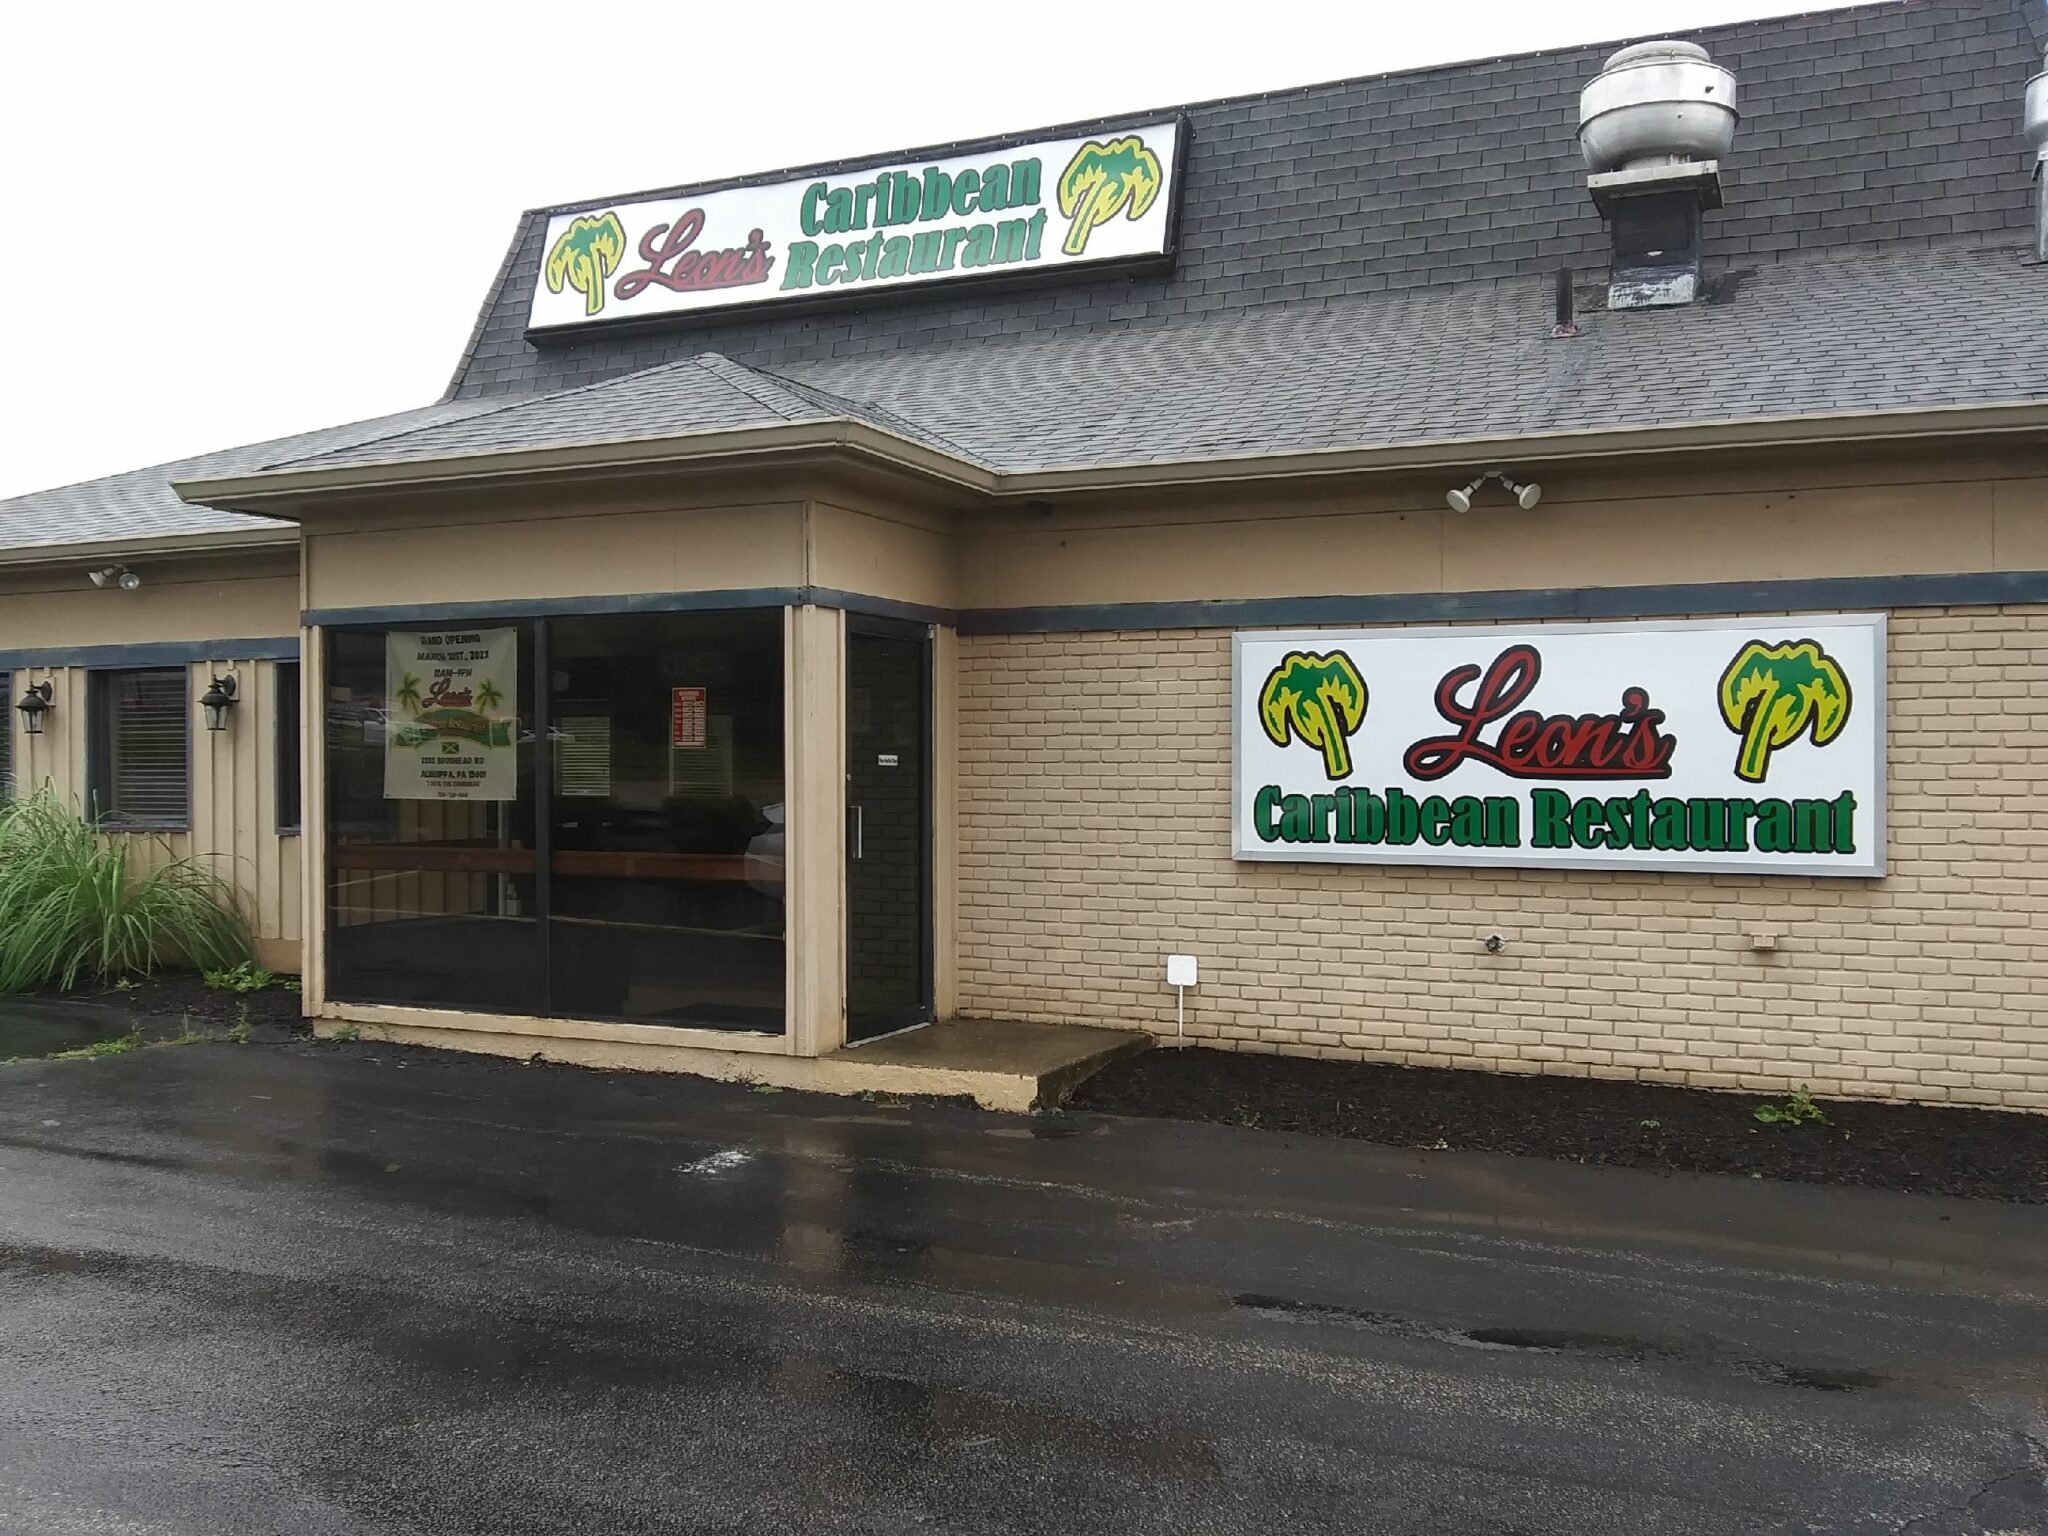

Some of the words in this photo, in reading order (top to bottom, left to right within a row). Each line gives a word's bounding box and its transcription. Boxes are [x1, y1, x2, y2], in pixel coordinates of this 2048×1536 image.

[799, 156, 1043, 236] Caribbean
[614, 207, 775, 300] Leon's
[780, 206, 1048, 291] Restaurant
[445, 634, 481, 645] OPENING
[1402, 644, 1677, 781] Leon's
[457, 770, 467, 779] PA
[1254, 785, 1521, 848] Caribbean
[1530, 788, 1858, 854] Restaurant
